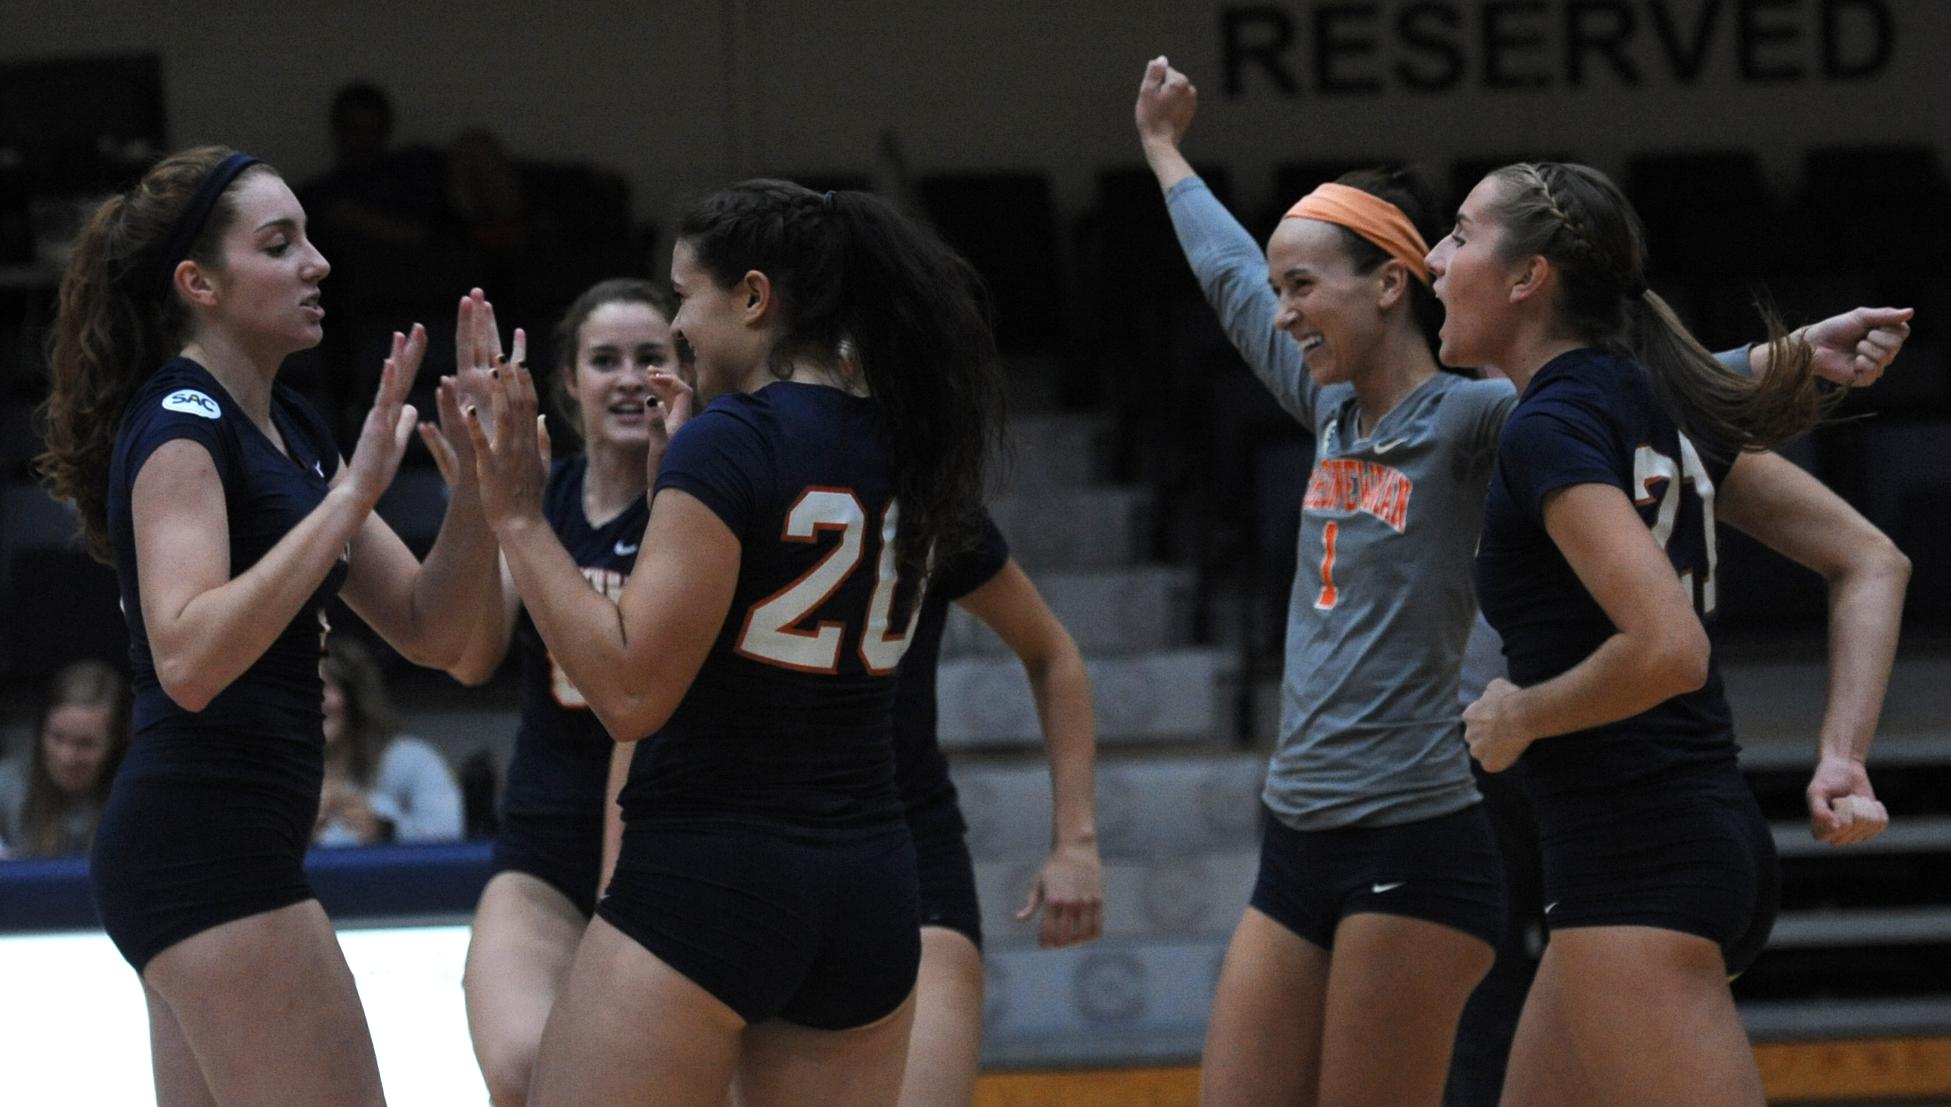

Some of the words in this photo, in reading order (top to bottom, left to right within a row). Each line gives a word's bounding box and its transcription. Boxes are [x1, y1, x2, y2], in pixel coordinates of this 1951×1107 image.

[1220, 0, 1898, 96] RESERVED
[172, 393, 215, 412] SAC
[733, 484, 937, 677] 20
[1313, 521, 1340, 609] 1
